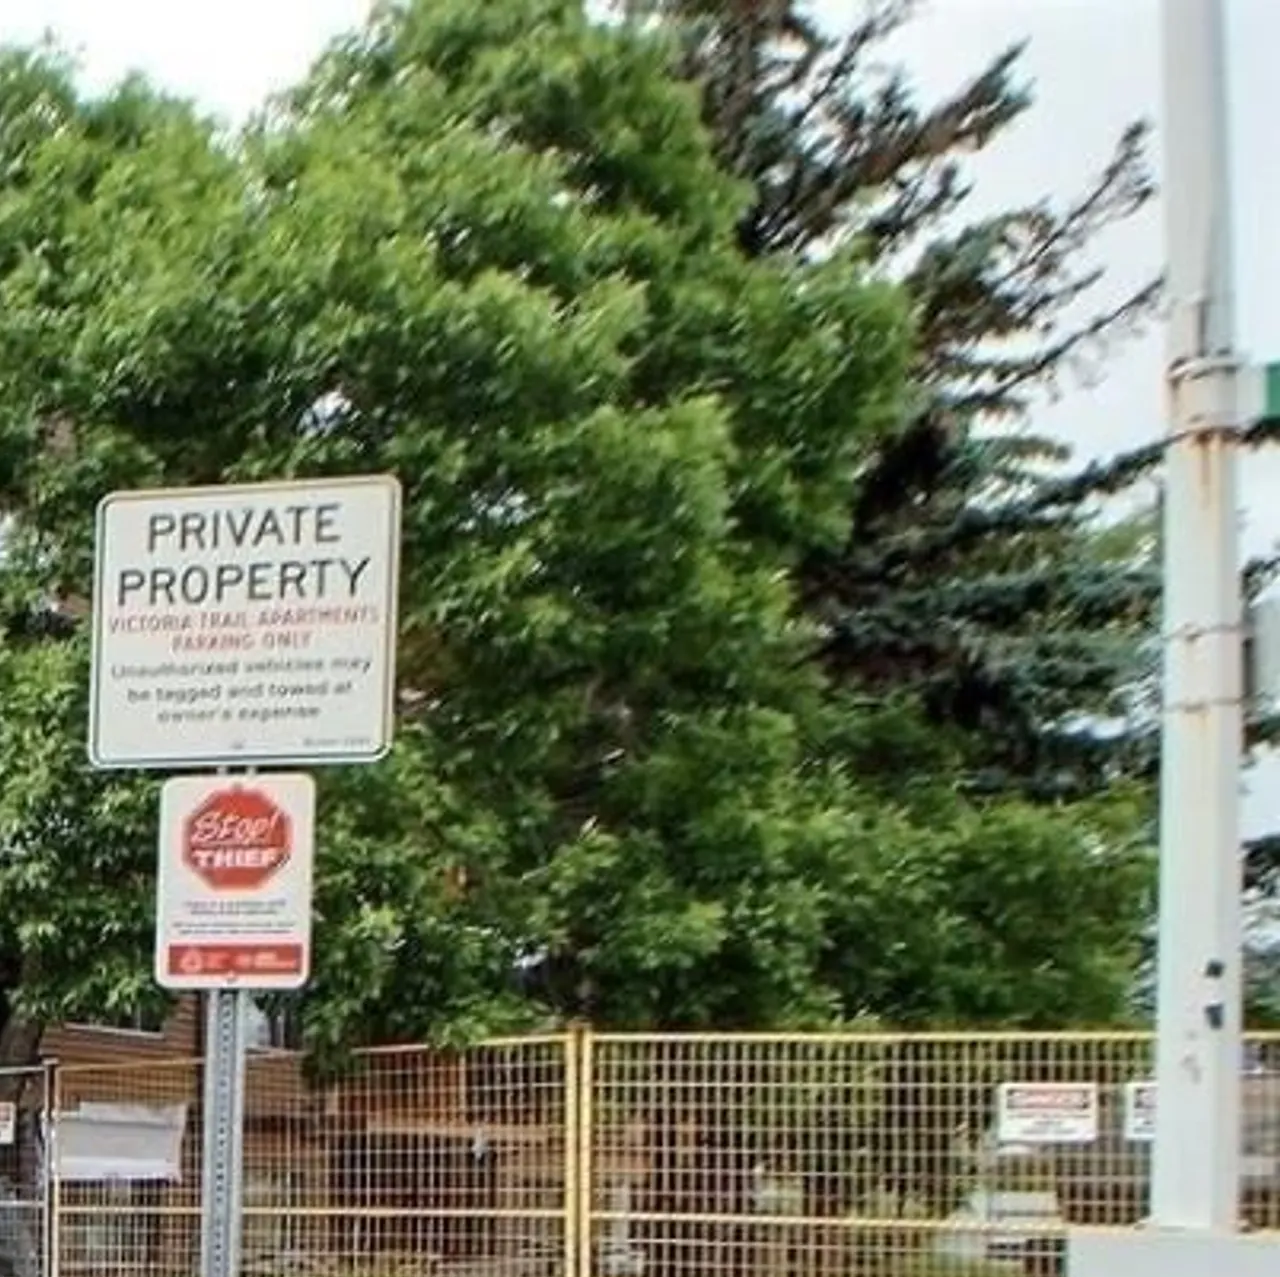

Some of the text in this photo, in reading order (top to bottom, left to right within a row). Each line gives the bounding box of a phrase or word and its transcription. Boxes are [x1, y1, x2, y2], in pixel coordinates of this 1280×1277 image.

[147, 503, 341, 552] PRIVATE
[117, 556, 371, 606] PROPERTY
[109, 613, 191, 634] VICTORIA
[172, 631, 311, 652] PARKING ONLY
[331, 657, 371, 674] may
[127, 688, 151, 703] be
[156, 684, 221, 704] tagged
[228, 684, 263, 699] and
[268, 682, 328, 698] towed
[238, 704, 321, 722] expense
[191, 848, 279, 867] THIEF
